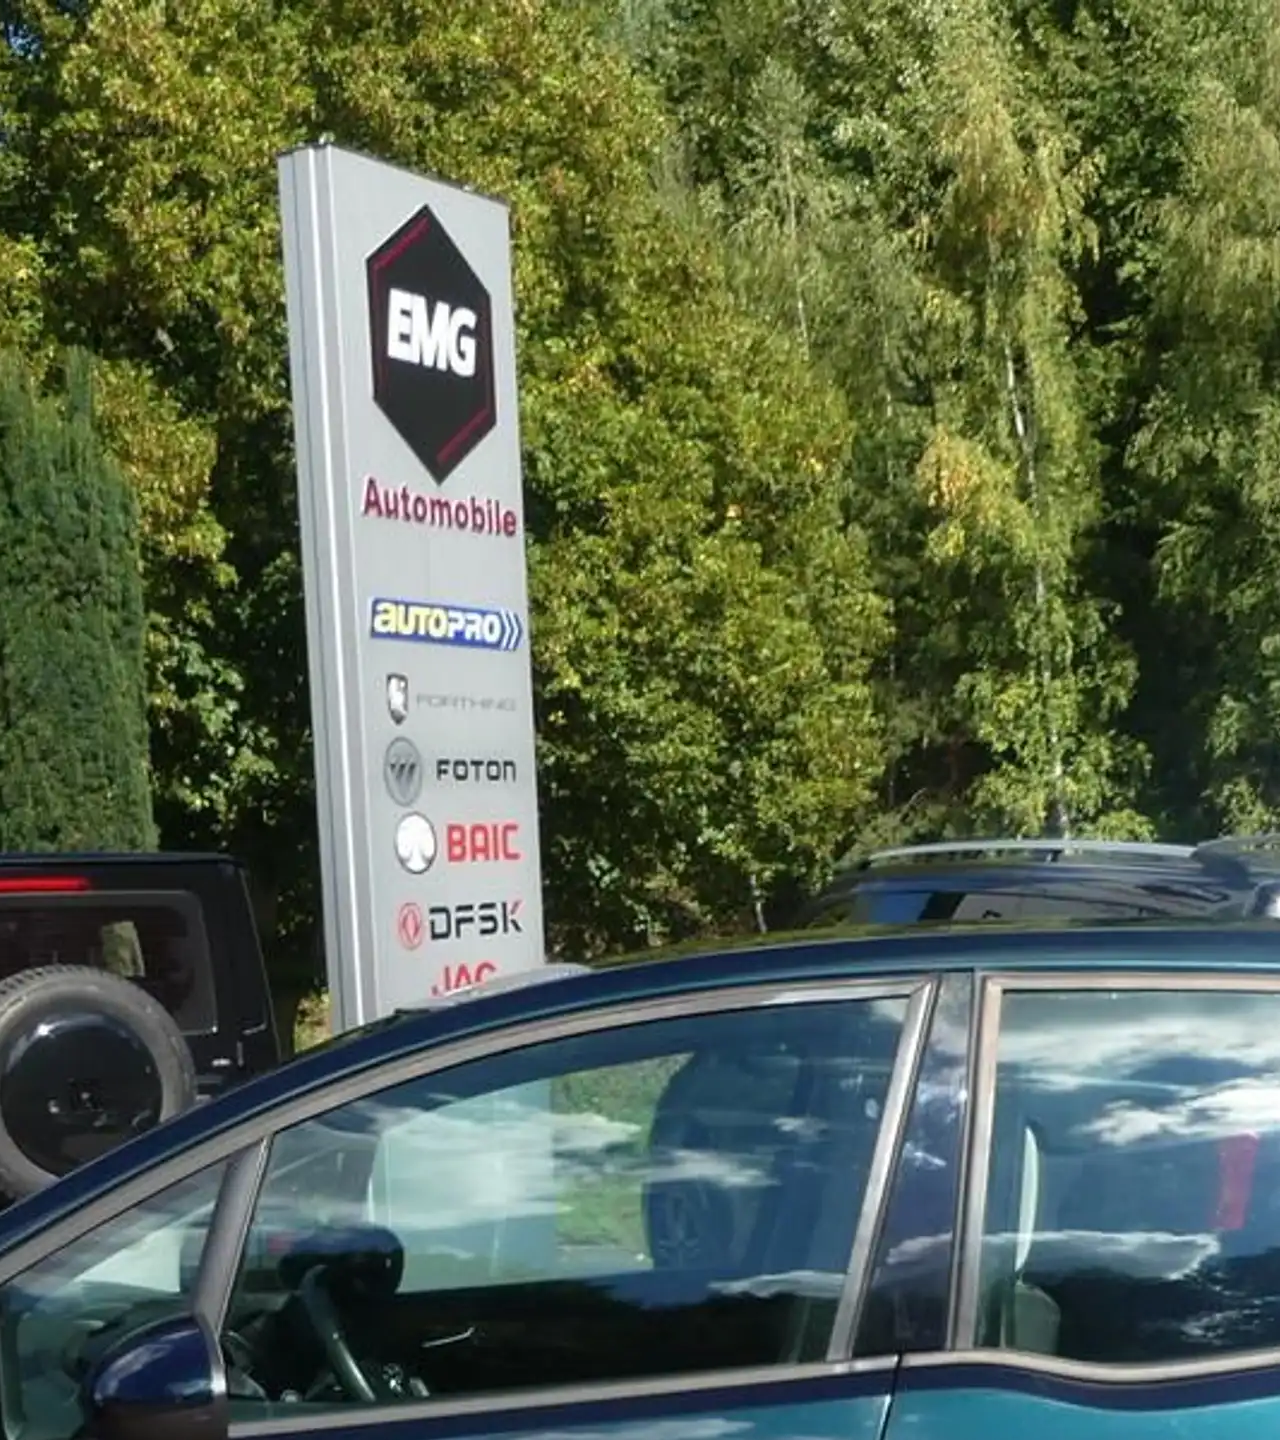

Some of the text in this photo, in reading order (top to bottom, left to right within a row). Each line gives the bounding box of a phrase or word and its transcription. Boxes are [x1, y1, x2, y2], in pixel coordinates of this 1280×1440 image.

[387, 287, 477, 378] EMG
[361, 477, 518, 538] Automobile
[436, 759, 517, 782] FOTON
[447, 823, 521, 863] BAIC
[428, 901, 523, 941] DFSK
[431, 961, 497, 996] JAC
